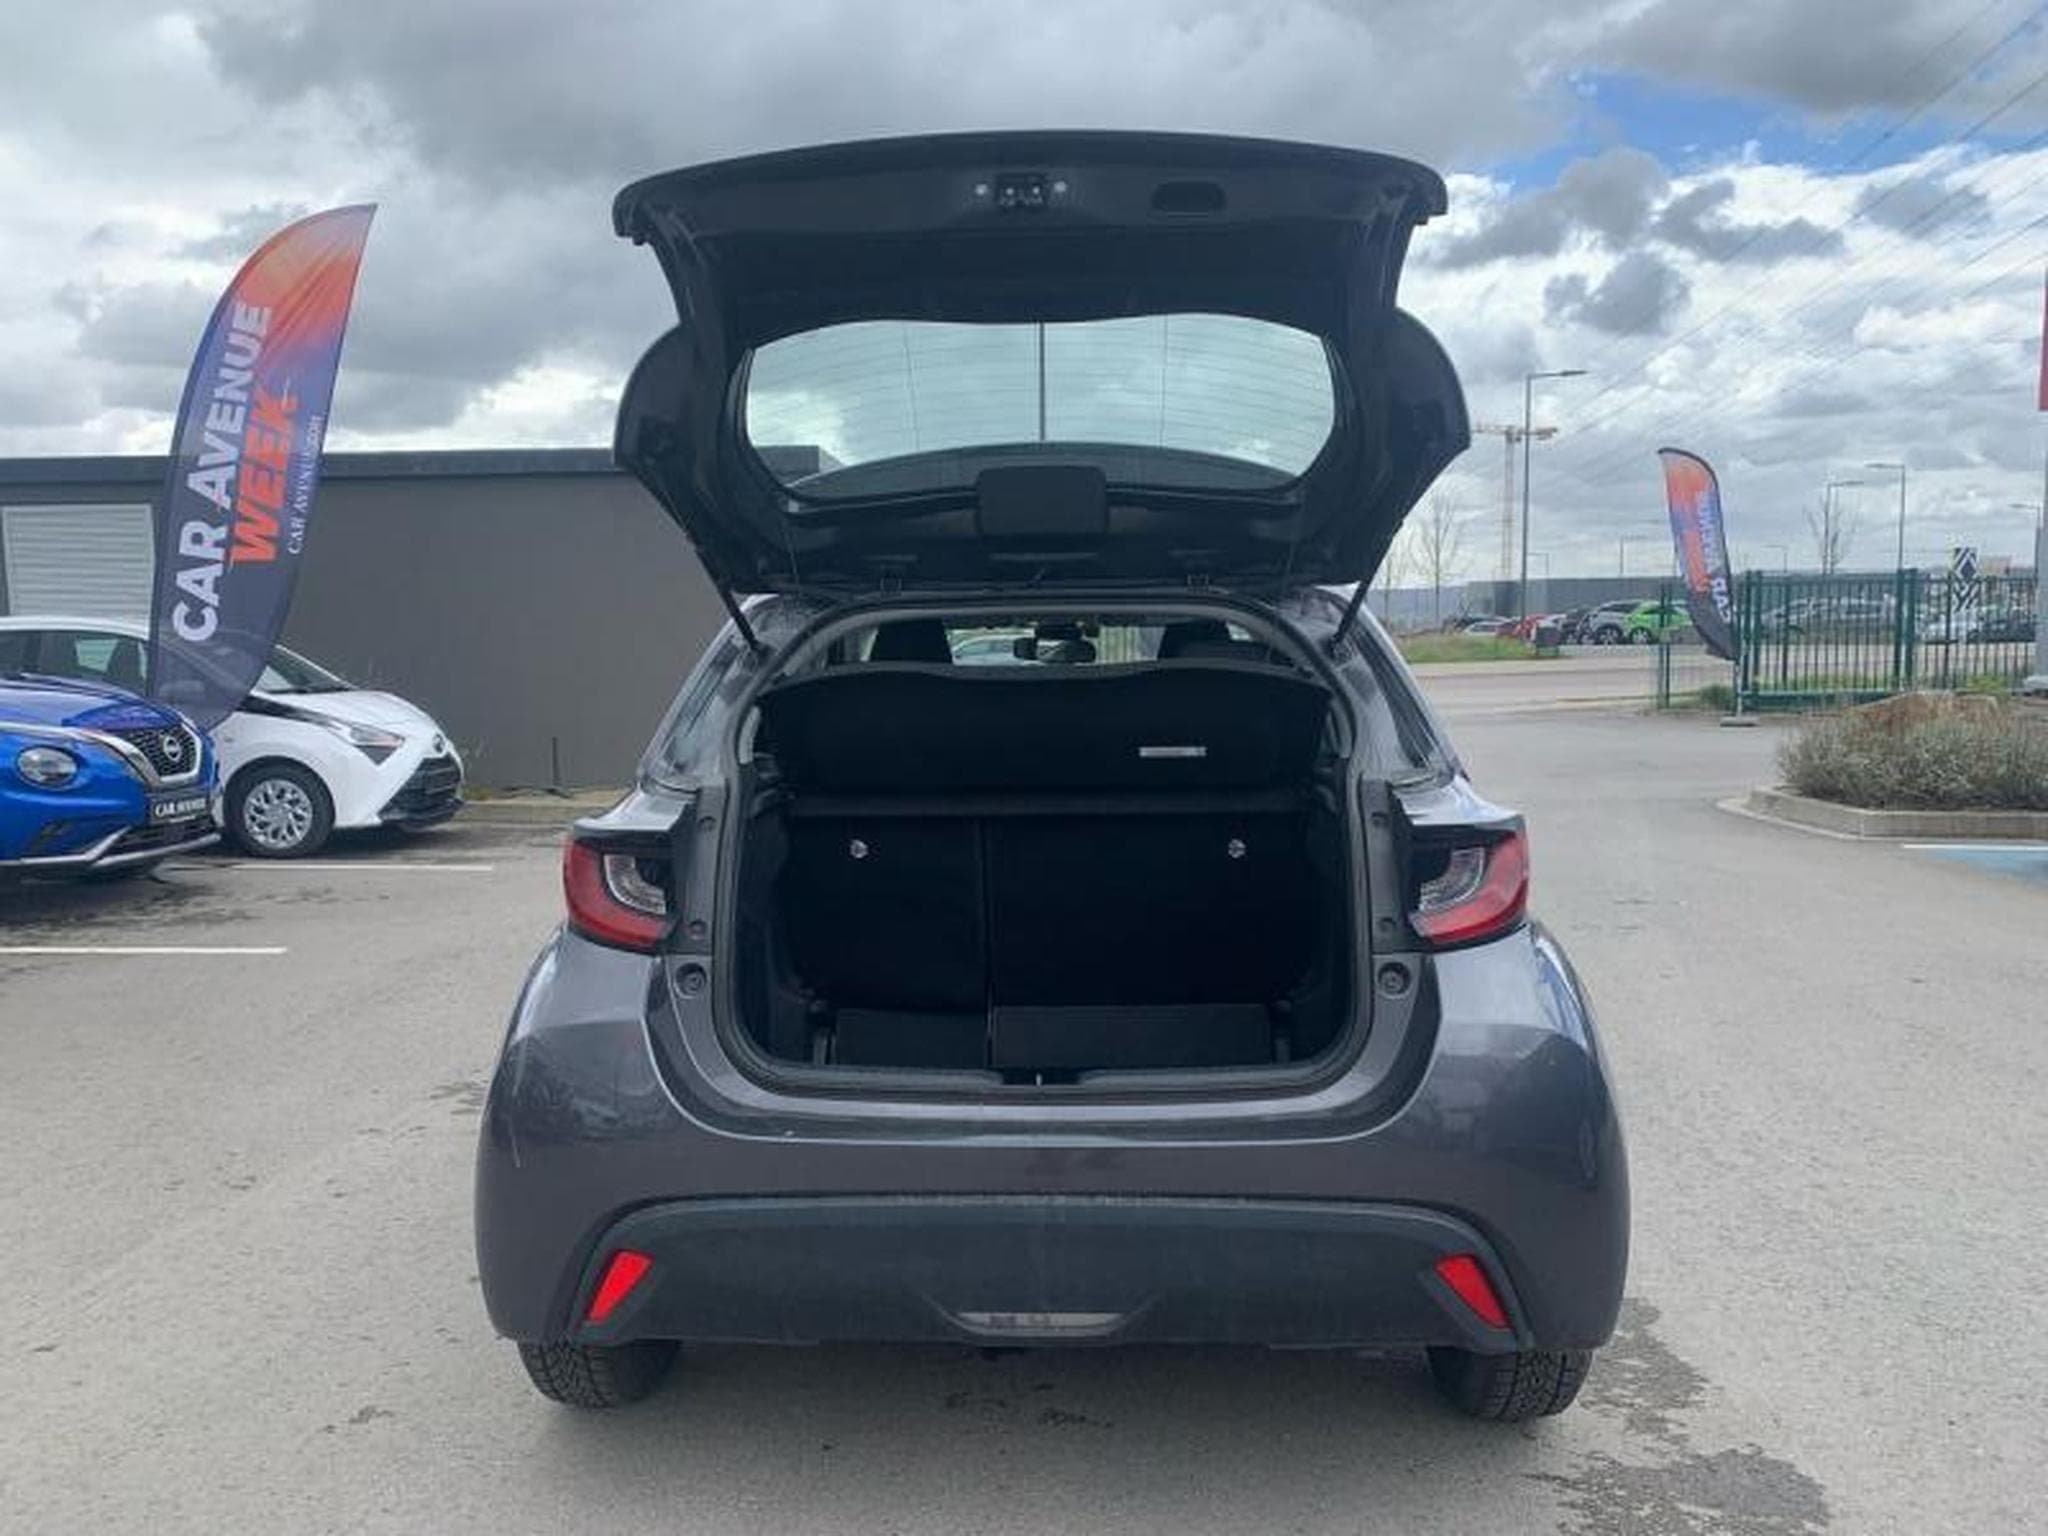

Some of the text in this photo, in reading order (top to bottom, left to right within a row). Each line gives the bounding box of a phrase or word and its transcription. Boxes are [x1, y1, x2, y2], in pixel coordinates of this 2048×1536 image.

[172, 302, 272, 642] CAR AVENUE
[231, 388, 298, 564] WEEK
[288, 517, 305, 555] CAR
